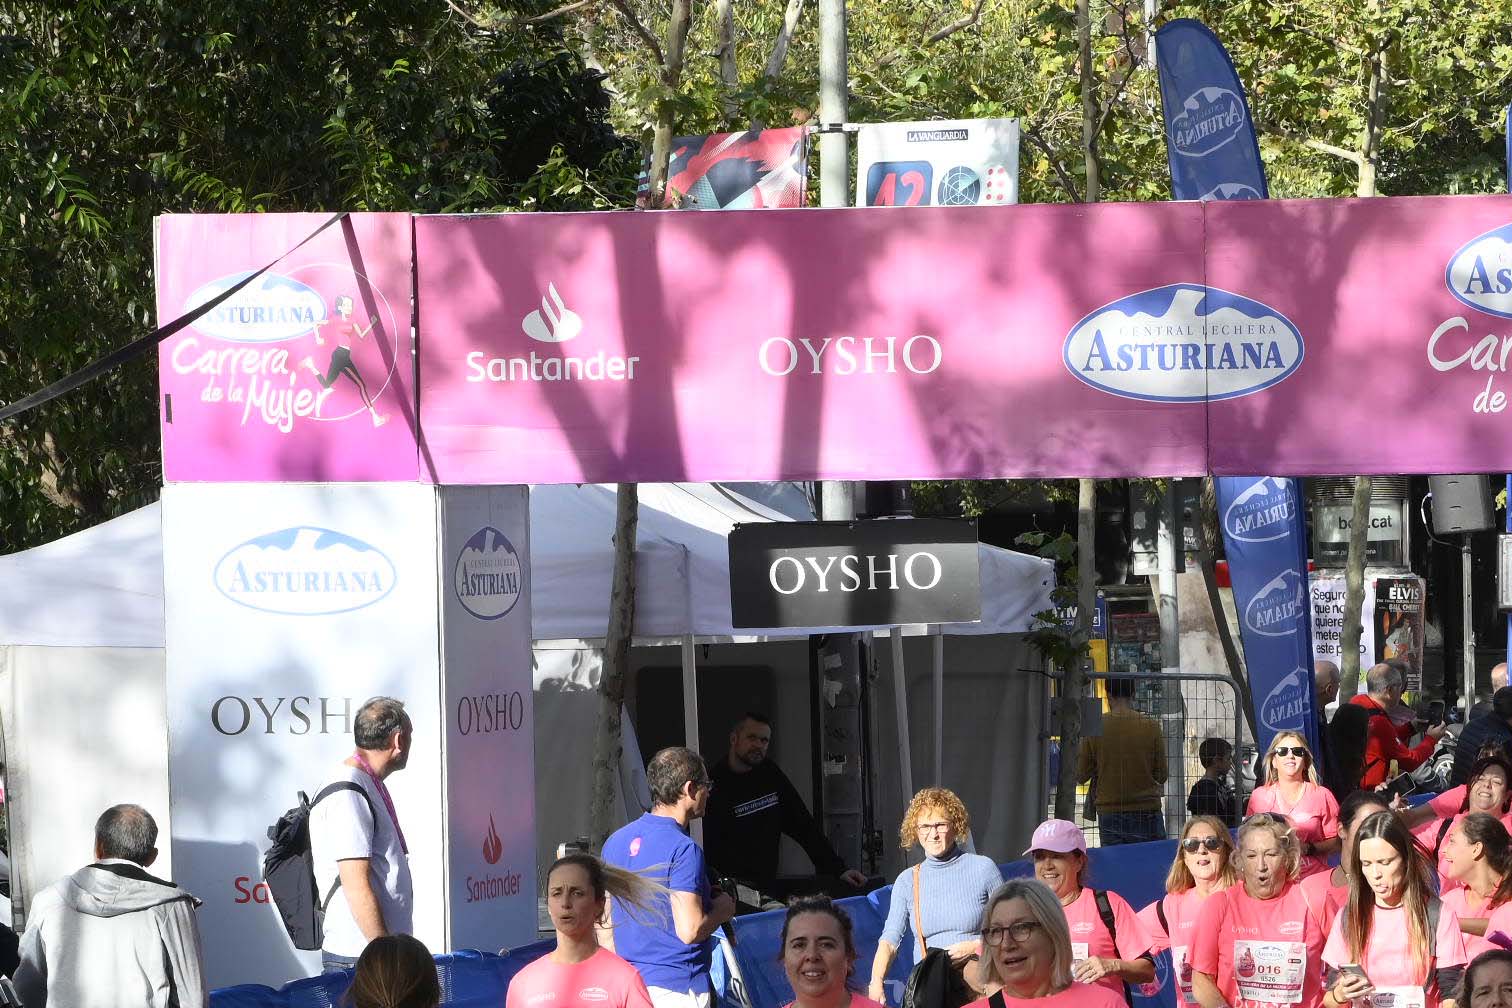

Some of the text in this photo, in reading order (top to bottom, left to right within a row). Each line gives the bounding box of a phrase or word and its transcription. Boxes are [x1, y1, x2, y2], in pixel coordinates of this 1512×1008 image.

[1119, 324, 1278, 337] CENTRAL LECHERA
[171, 337, 290, 376] Carrera
[465, 351, 640, 382] Santander
[758, 335, 943, 376] OYSHO
[1081, 342, 1283, 373] ASTURIANA
[201, 372, 335, 434] de la Mujer
[1472, 374, 1507, 414] de
[228, 559, 384, 594] ASTURIANA
[460, 561, 518, 597] ASTURIANA
[769, 551, 943, 595] OYSHO
[1314, 604, 1331, 614] que
[1389, 587, 1419, 600] ELVIS
[1316, 643, 1335, 654] este
[211, 695, 354, 736] OYSH
[457, 690, 524, 738] OYSHO
[466, 871, 522, 904] Santander
[1257, 965, 1281, 975] 016
